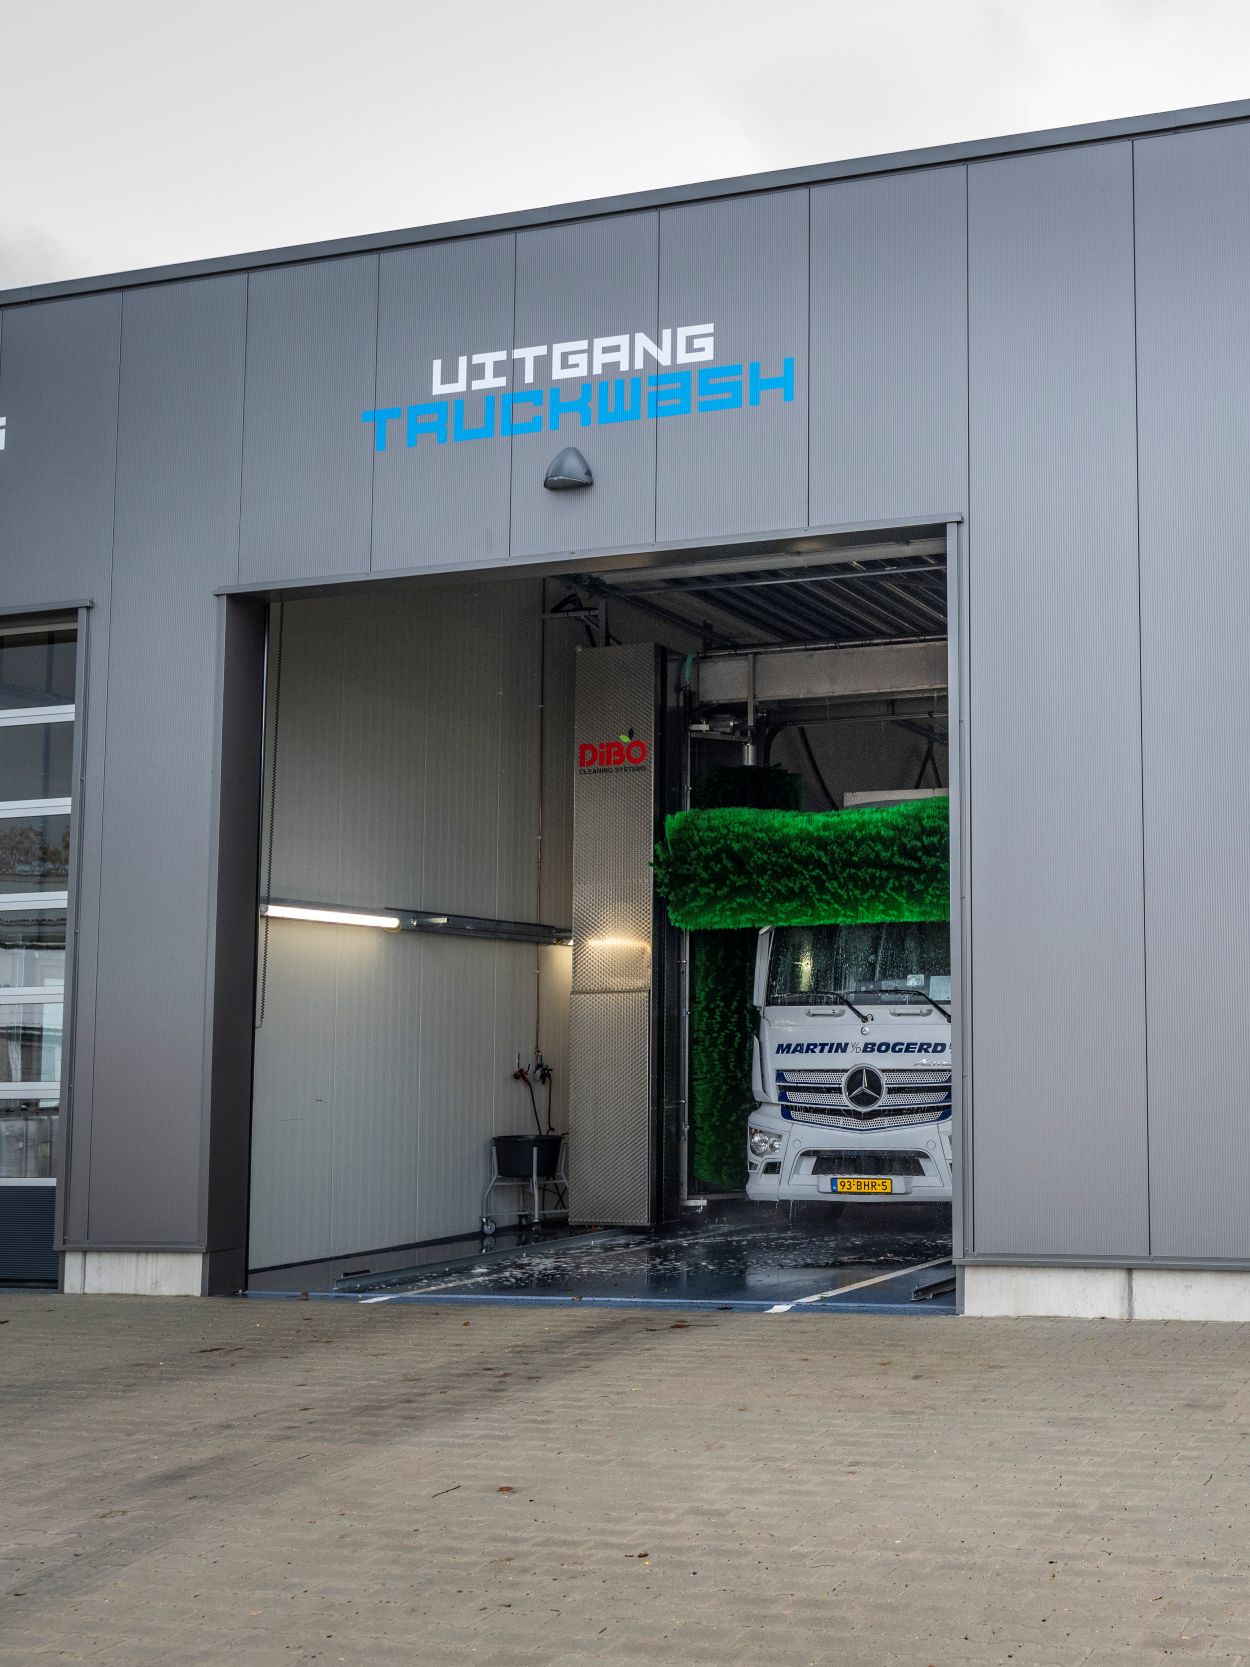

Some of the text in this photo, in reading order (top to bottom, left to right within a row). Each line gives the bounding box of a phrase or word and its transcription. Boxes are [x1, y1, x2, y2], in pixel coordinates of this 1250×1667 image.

[431, 322, 715, 396] UITGANG
[776, 1042, 849, 1054] MARTIN
[862, 1042, 946, 1054] BOGERD
[839, 1180, 888, 1191] 93-BHR-5
